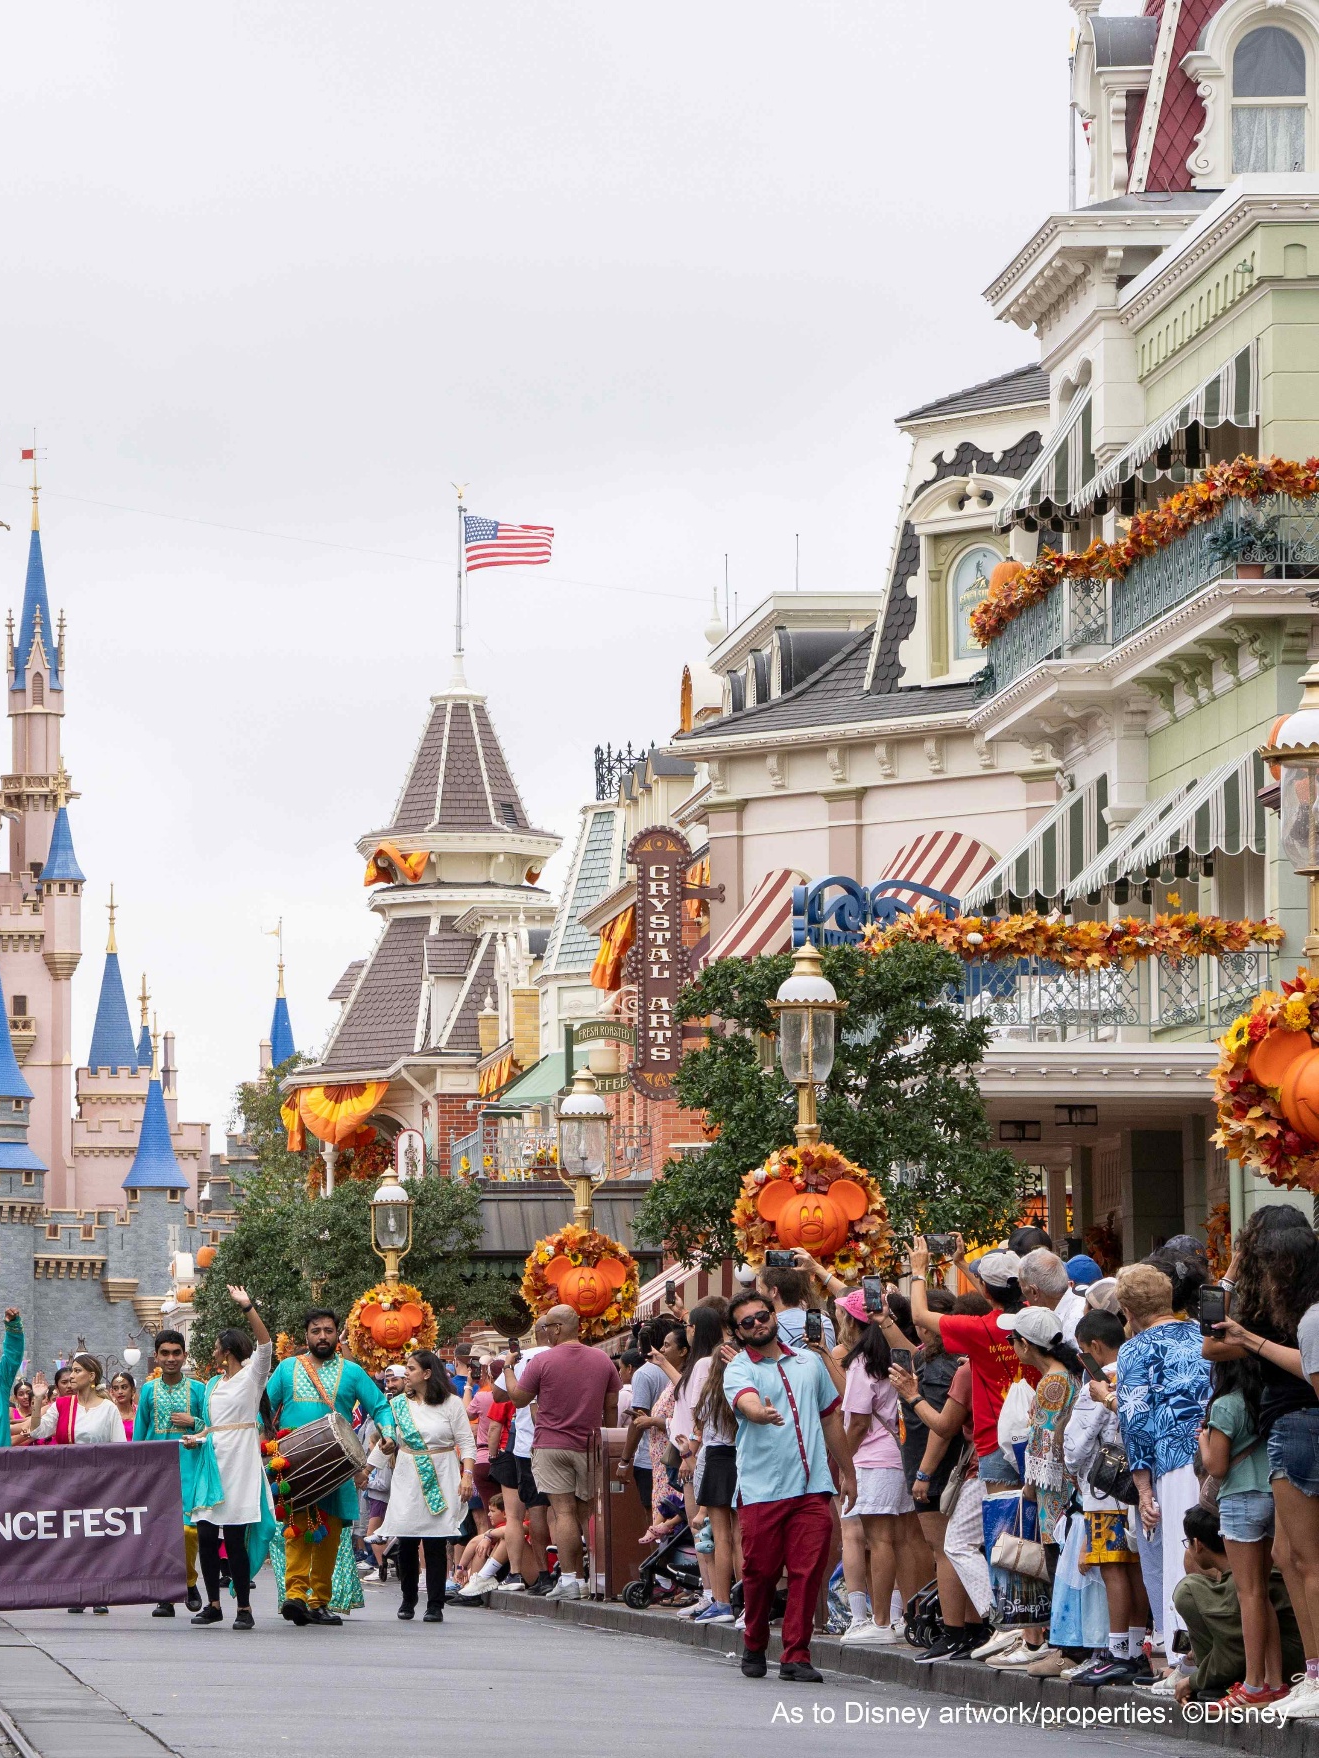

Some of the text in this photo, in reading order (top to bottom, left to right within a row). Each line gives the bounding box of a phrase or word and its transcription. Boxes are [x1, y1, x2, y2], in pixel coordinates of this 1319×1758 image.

[647, 865, 673, 1061] CRYSTAL ARTS
[578, 1025, 630, 1040] FRESH ROASTED
[594, 1075, 628, 1091] OFFEE
[989, 1343, 1014, 1354] Where
[63, 1506, 148, 1538] FEST
